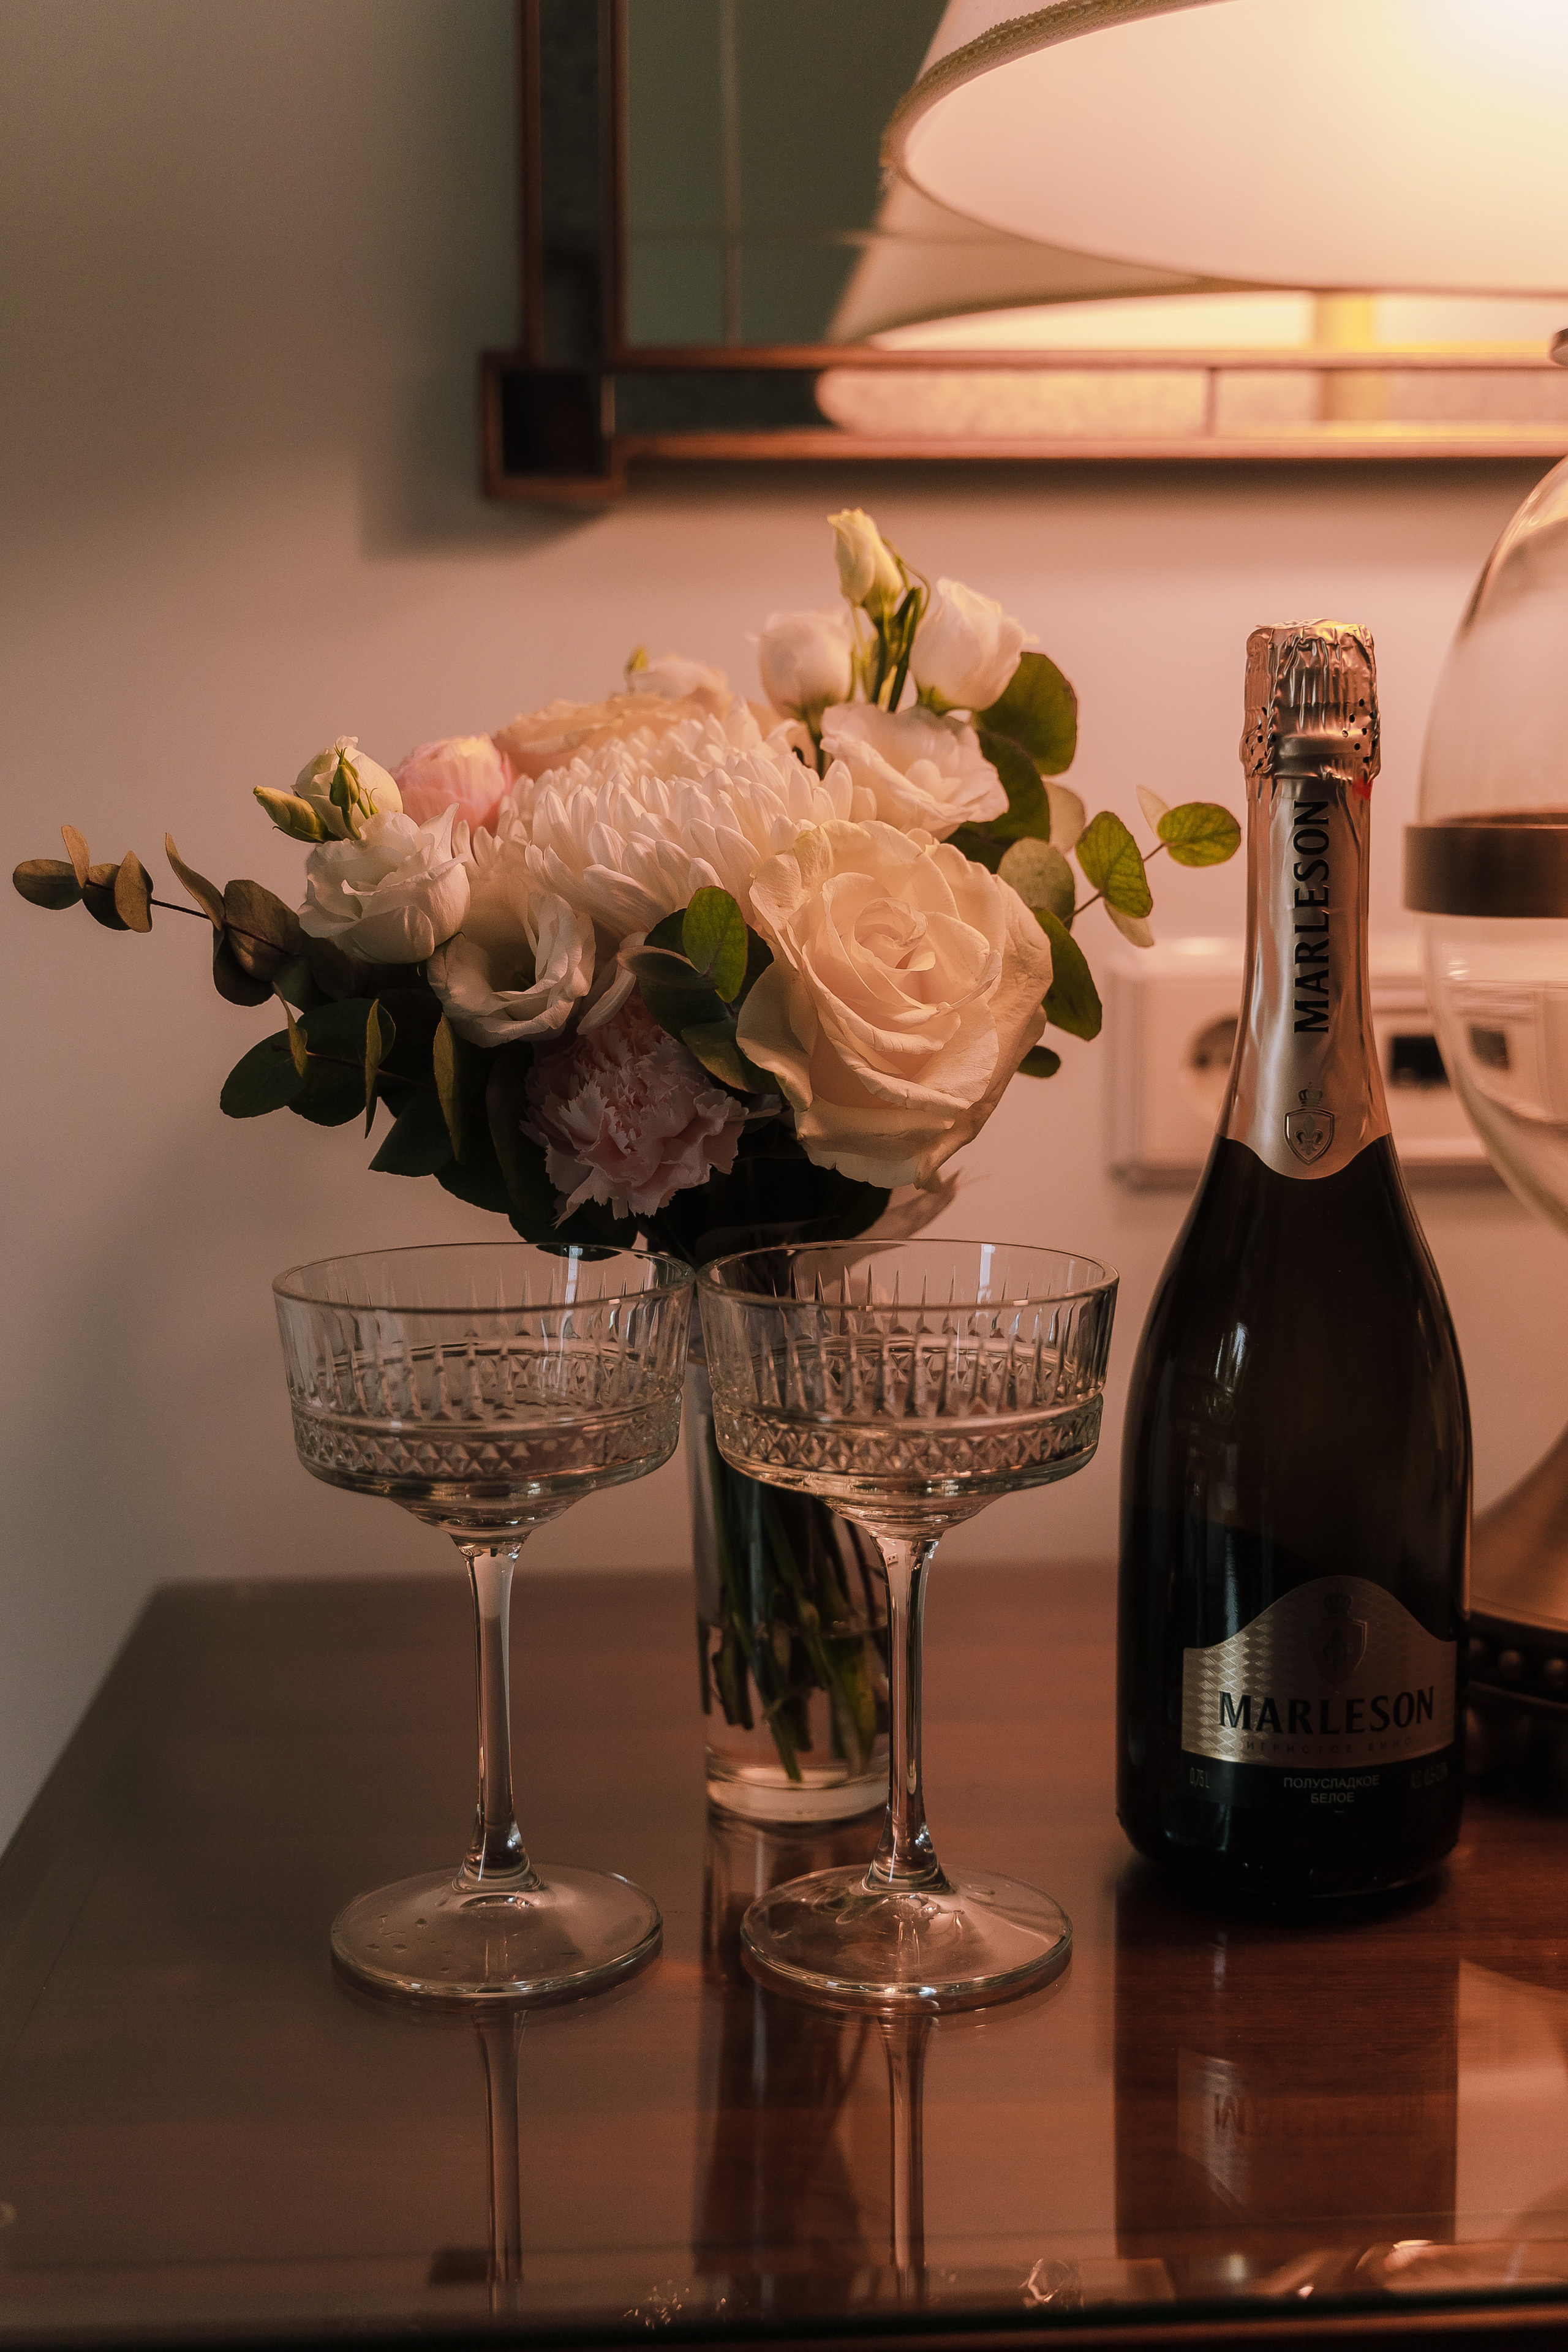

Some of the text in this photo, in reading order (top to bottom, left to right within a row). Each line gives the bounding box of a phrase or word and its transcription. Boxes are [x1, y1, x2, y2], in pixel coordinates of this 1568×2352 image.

[1293, 800, 1330, 1033] MARLESON
[1218, 1685, 1434, 1735] MARLESON
[1246, 1736, 1412, 1755] ИГРИСТОЕ ВИНО
[1283, 1774, 1381, 1789] ПОЛУСЛАДКОЕ
[1311, 1792, 1355, 1804] БЕЛОЕ
